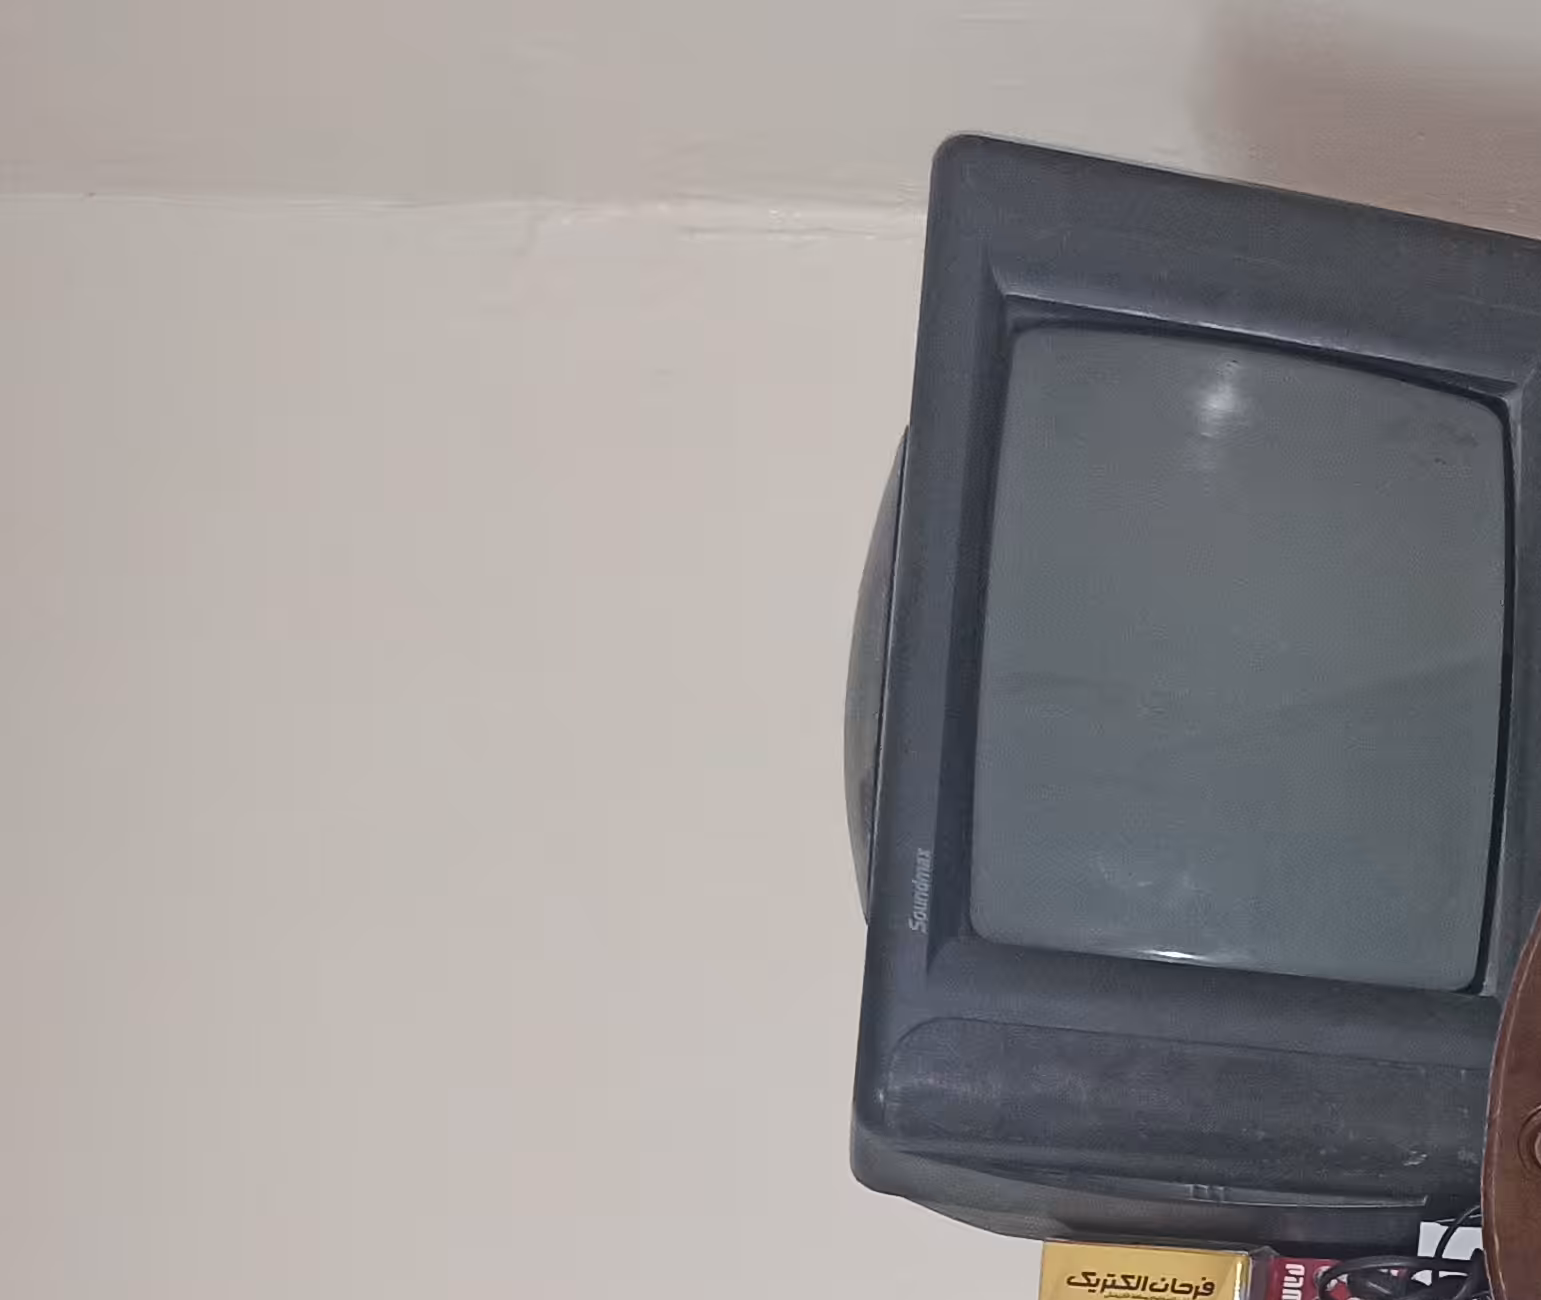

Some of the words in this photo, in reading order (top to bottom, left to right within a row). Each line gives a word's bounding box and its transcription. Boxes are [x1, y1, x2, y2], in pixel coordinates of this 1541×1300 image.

[907, 847, 932, 932] Soundmax
[1066, 1271, 1149, 1294] الکتریک
[1149, 1276, 1216, 1297] فرحان
